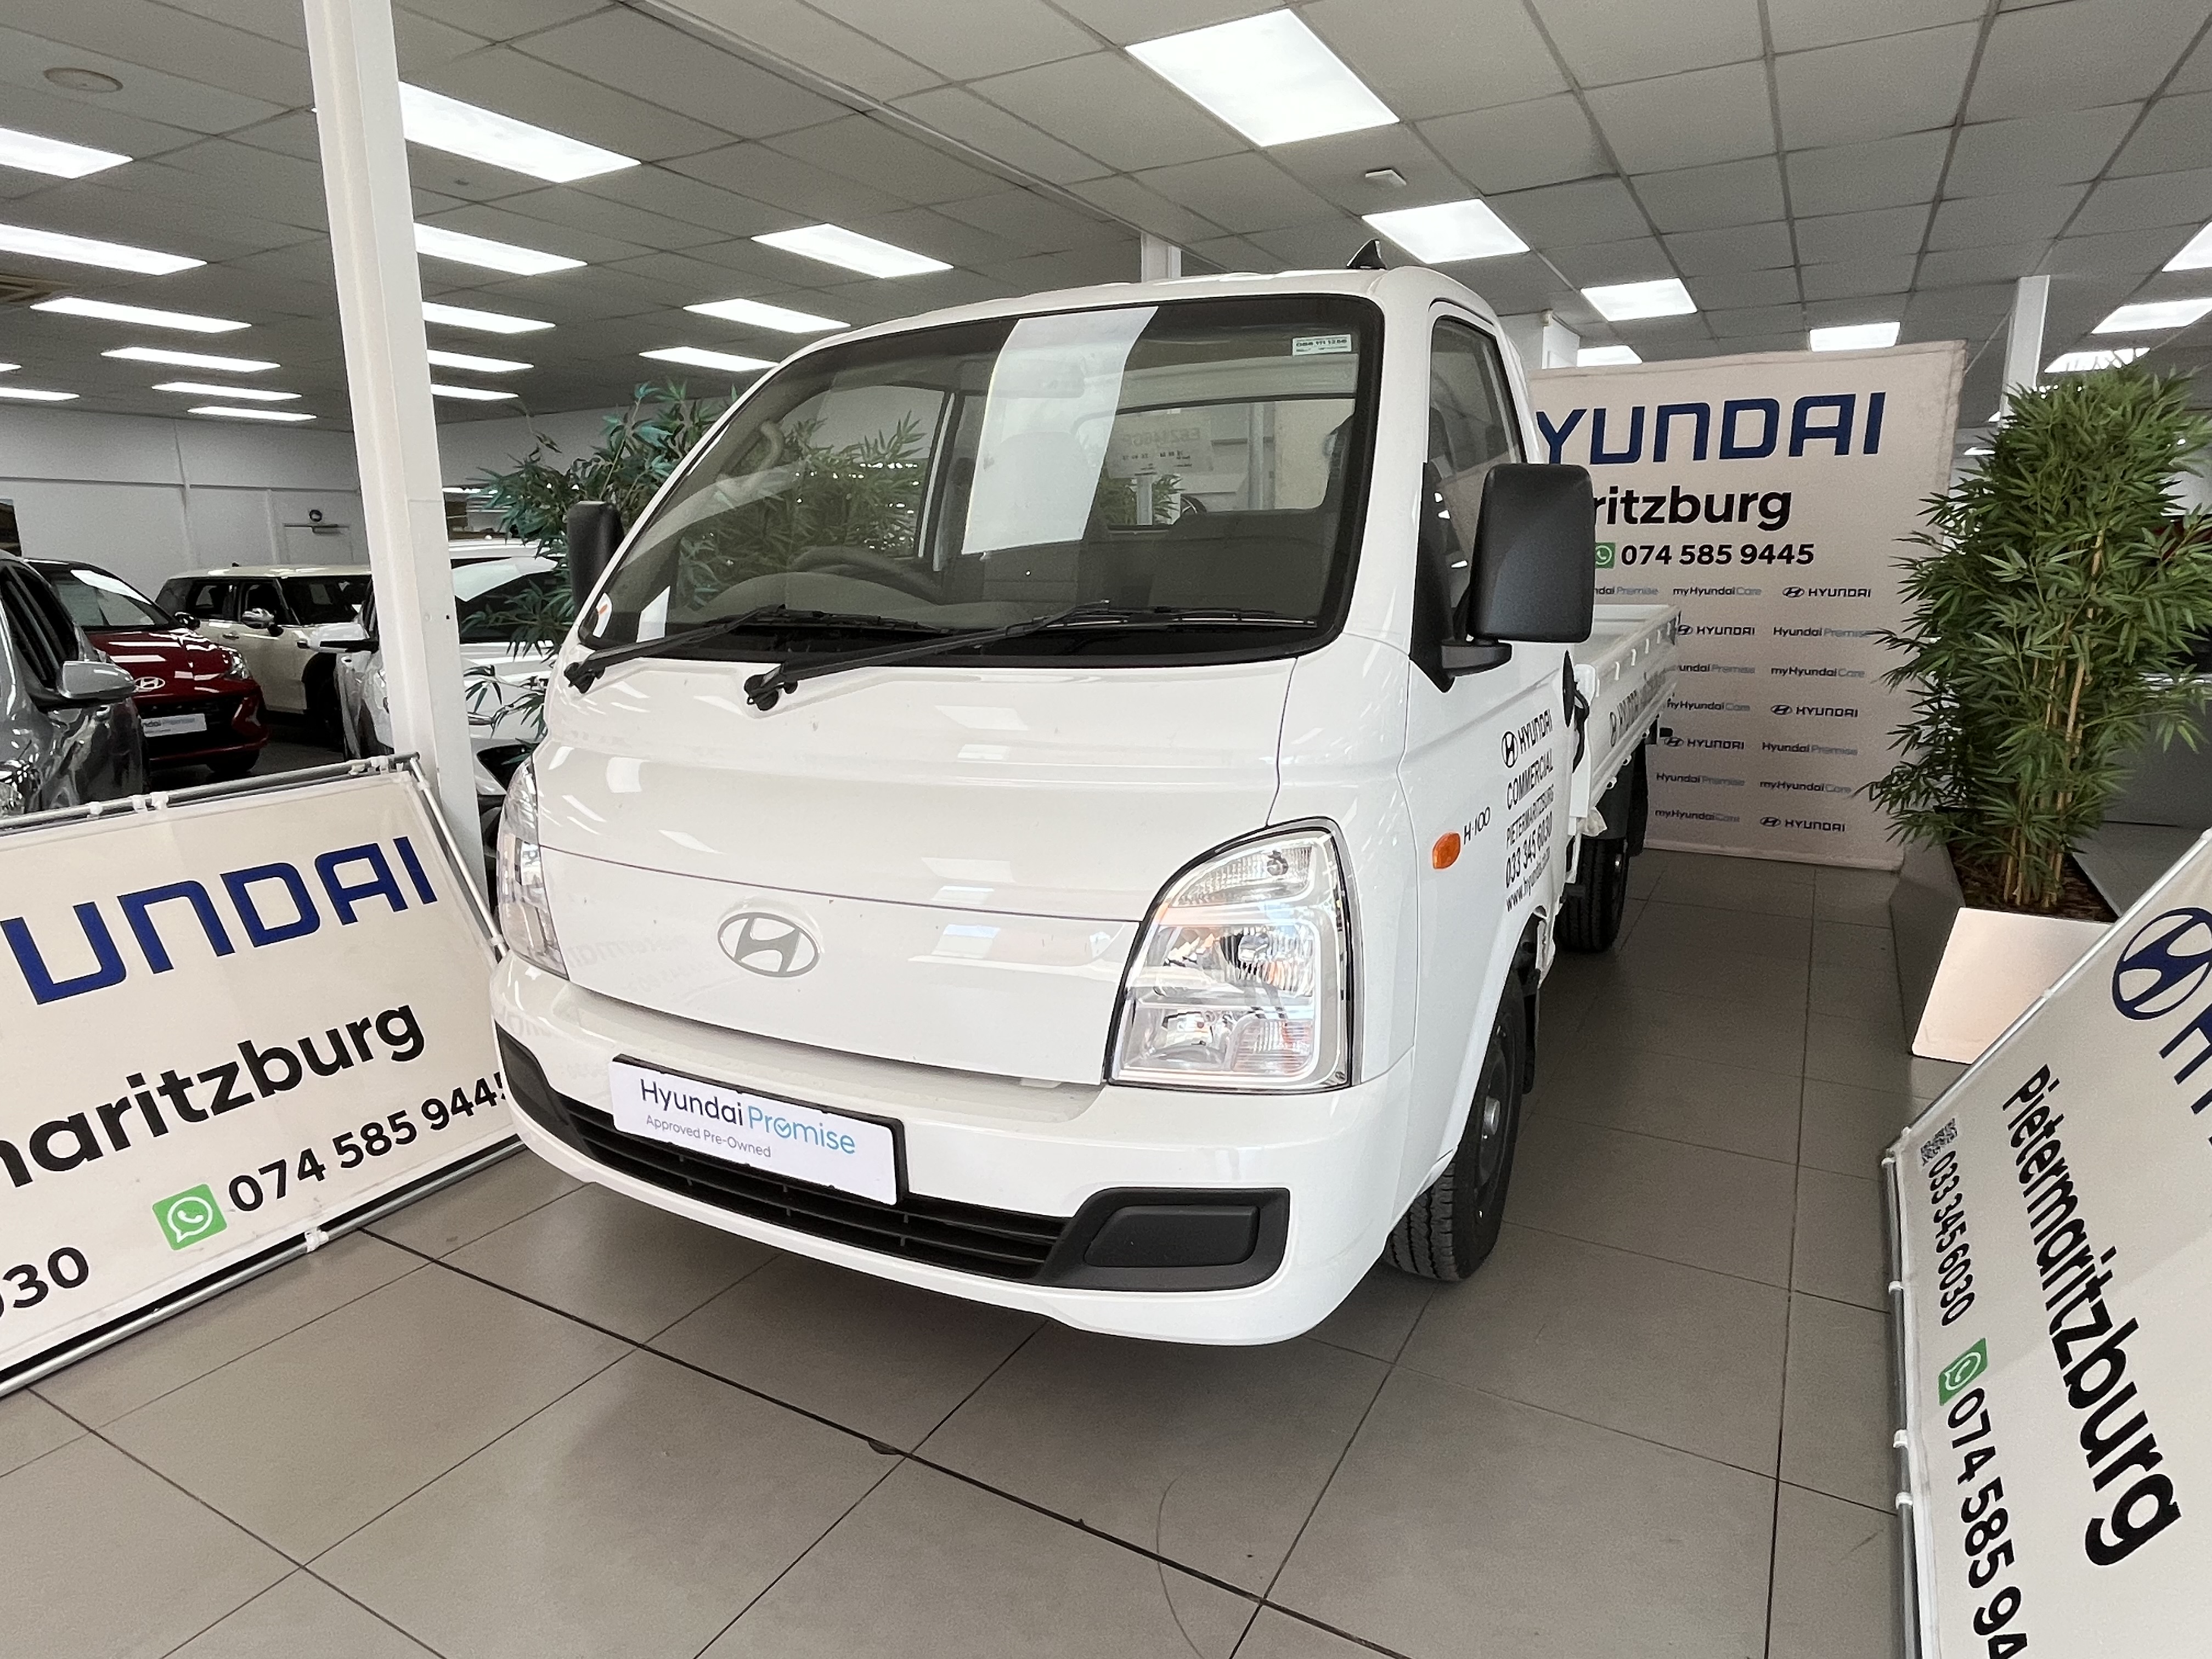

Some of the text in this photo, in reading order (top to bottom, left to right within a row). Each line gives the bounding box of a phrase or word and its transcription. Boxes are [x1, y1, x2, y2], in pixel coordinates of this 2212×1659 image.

[1621, 543, 1814, 566] 074 585 9445
[1808, 588, 1871, 598] HYUNDAI
[1696, 625, 1756, 636] HYUNDAI
[1517, 708, 1553, 755] HYUNDAI
[1796, 706, 1859, 718] HYUNDAI
[1686, 738, 1745, 750] HYUNDAI
[1506, 747, 1554, 810] COMMERCIAL
[1785, 819, 1846, 832] HYUNDAI
[1505, 846, 1521, 889] 033
[646, 1114, 771, 1158] Approved Pre-Owned
[229, 1147, 326, 1211] 074
[332, 1109, 417, 1169] 585
[1928, 1150, 1975, 1327] 033 345 6030
[0, 1247, 89, 1319] 30
[2002, 1063, 2181, 1566] Pietermaritzburg
[1948, 1387, 1996, 1486] 074
[1961, 1476, 2015, 1589] 585
